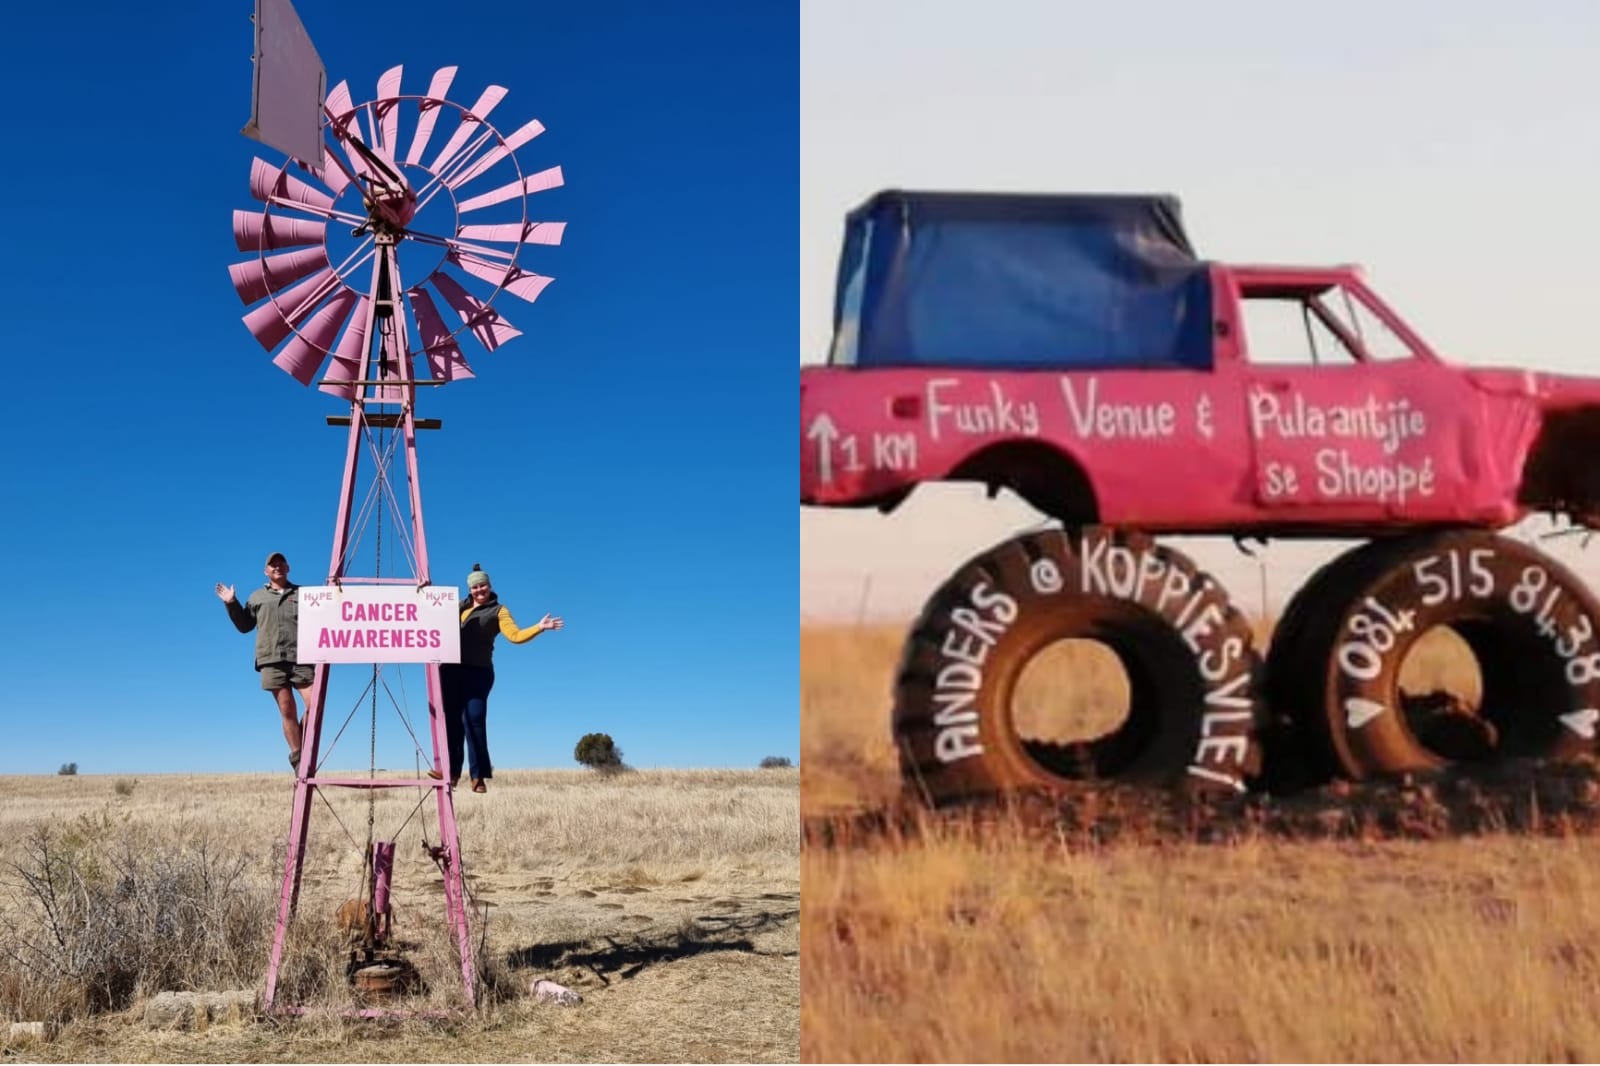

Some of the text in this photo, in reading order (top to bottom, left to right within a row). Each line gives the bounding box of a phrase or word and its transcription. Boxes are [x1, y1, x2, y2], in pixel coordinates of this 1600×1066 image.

[926, 378, 1041, 441] Funky
[1060, 377, 1176, 438] Venue
[840, 433, 918, 472] 1 KM
[1315, 448, 1436, 504] Shoppé
[318, 627, 441, 649] AWARENESS
[1338, 549, 1600, 686] 084 515 8438
[932, 582, 1020, 764] ANDERS
[1029, 558, 1064, 594] @
